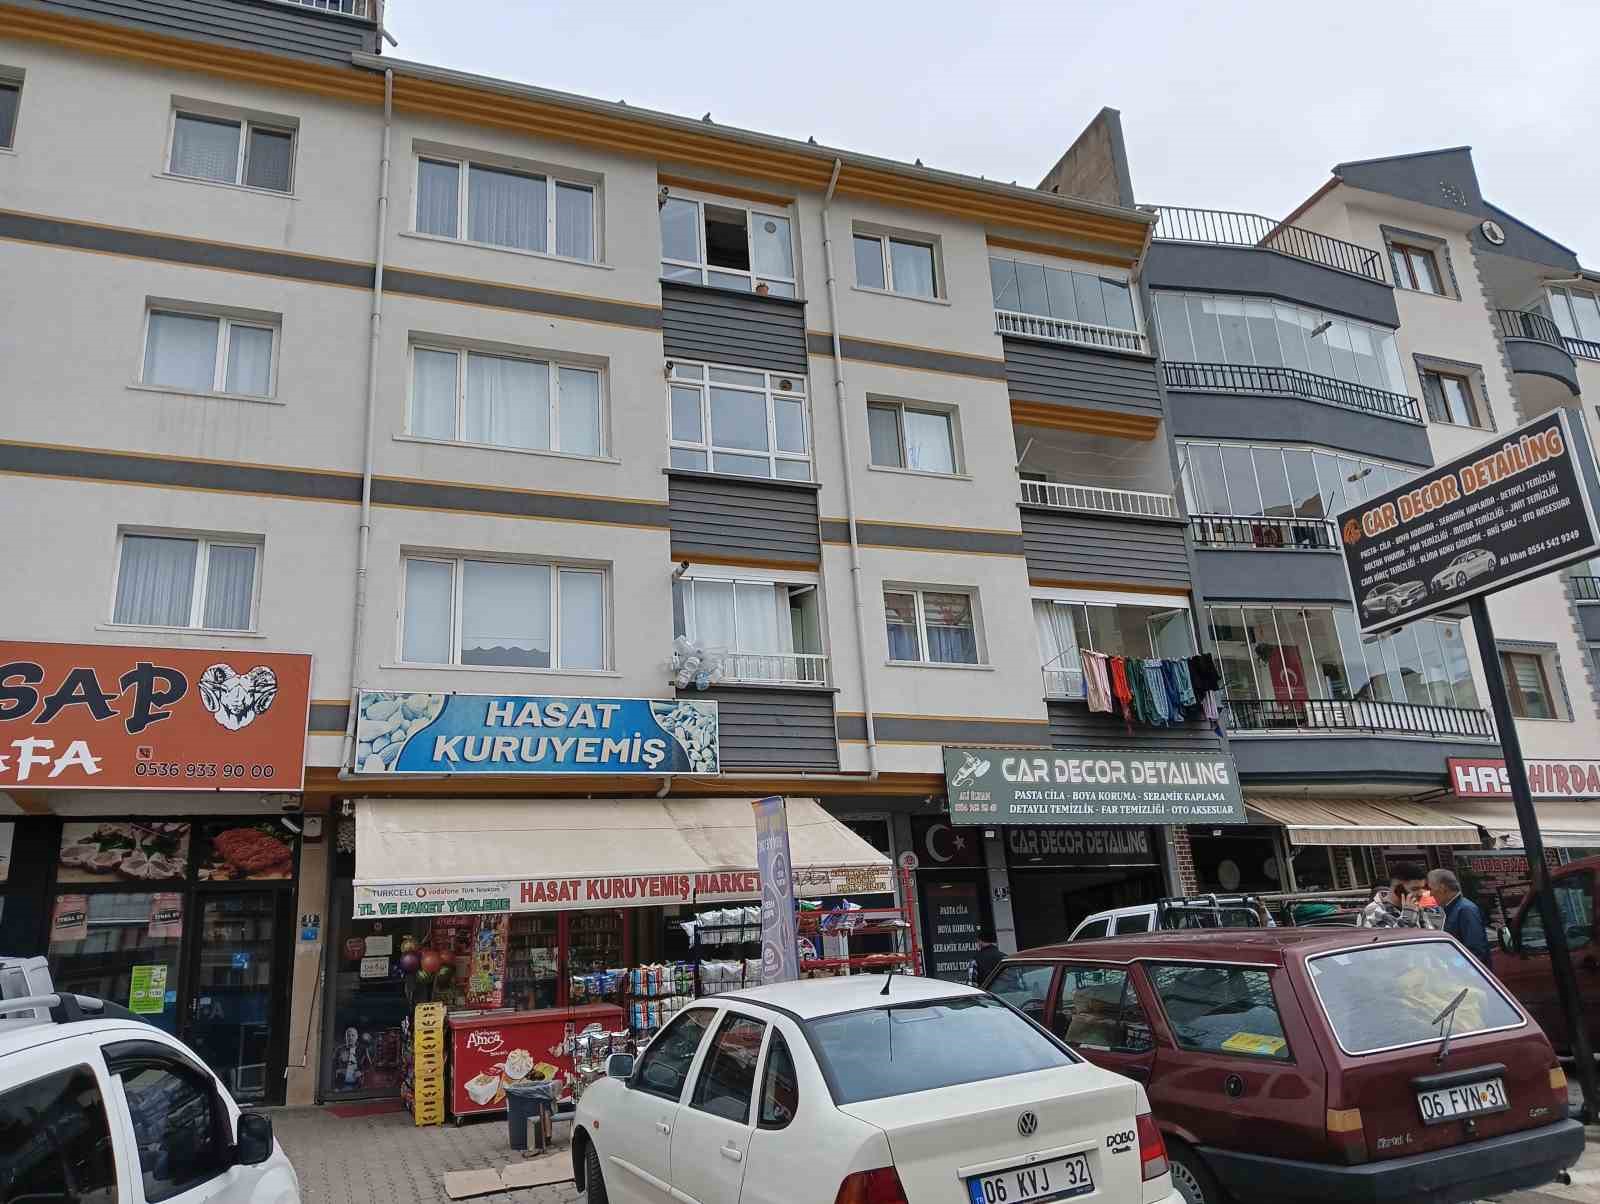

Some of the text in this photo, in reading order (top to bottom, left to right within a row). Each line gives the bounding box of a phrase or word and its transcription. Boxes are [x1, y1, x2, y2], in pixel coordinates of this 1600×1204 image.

[1361, 502, 1399, 537] CAR
[1397, 475, 1461, 524] DECOR
[485, 701, 620, 729] HASAT
[0, 737, 103, 781] FA
[432, 731, 667, 769] KURUYEMİŞ
[136, 762, 275, 778] 0536 933 90 00
[1001, 757, 1230, 785] CAR DECOR DETAILING
[1528, 764, 1600, 795] HIRDA
[1010, 804, 1048, 814] DETAYLI
[1050, 801, 1095, 814] TEMİZLİK
[1101, 805, 1118, 814] FAR
[1171, 806, 1190, 814] OTO
[1192, 806, 1234, 815] AKSESUAR
[1015, 788, 1225, 801] PASTA CİLA BOYA KORUMA SERAMİK KAPLAMA
[1010, 831, 1148, 854] CAR DECOR DETAILING
[372, 889, 414, 897] TURKCELL
[428, 887, 459, 895] vodafone
[520, 879, 581, 904] HASAT
[695, 870, 762, 894] MARKET
[358, 898, 511, 916] TL VE PAKET YÜKLEME
[466, 1032, 500, 1048] Amca
[1421, 1082, 1505, 1118] 06 FVN 31
[984, 1159, 1088, 1204] 06 KVJ 32
